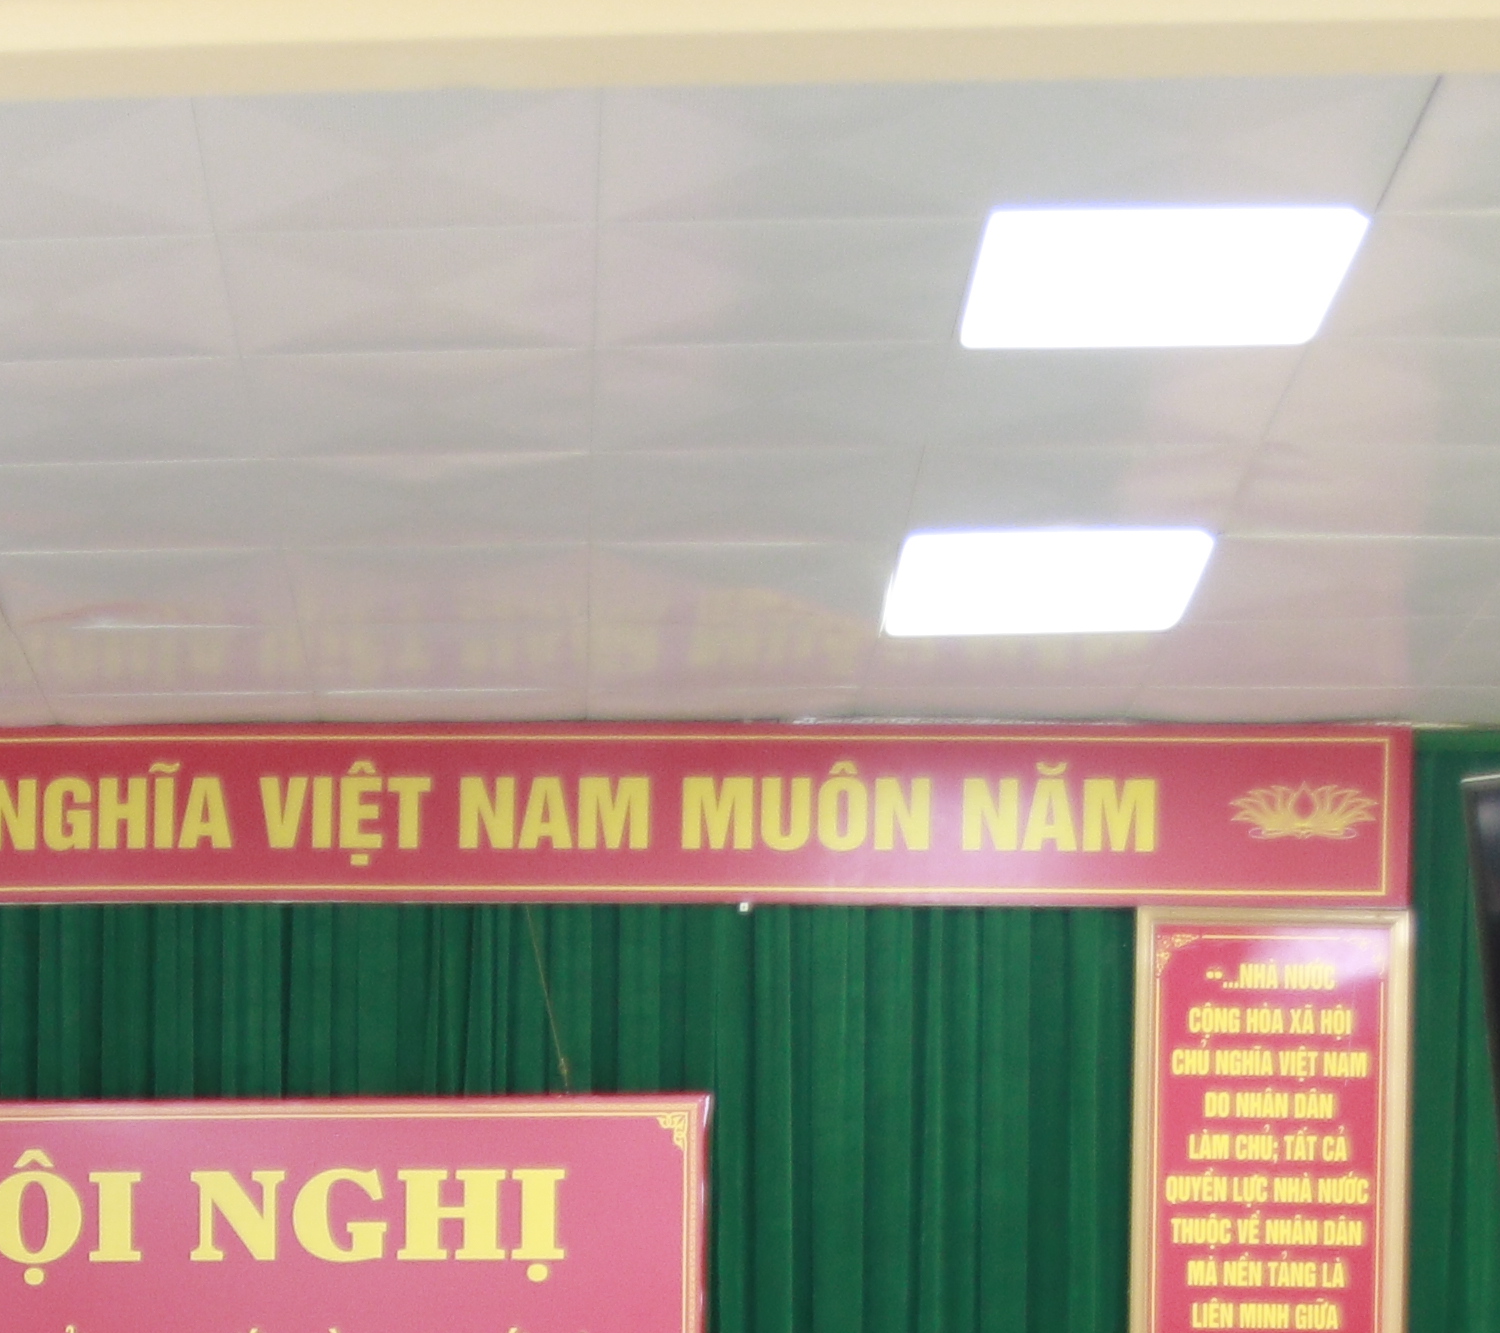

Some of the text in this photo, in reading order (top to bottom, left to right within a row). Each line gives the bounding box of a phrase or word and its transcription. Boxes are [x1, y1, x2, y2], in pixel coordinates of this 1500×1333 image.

[259, 760, 432, 867] VIỆT
[459, 776, 651, 850] NAM
[681, 761, 937, 857] MUÔN
[957, 762, 1158, 858] NĂM
[1189, 1002, 1353, 1040] CỘNG HÒA XÃ HỘI
[1172, 1039, 1367, 1081] CHỦ NGHĨA VIỆT NAM
[1205, 1088, 1334, 1118] DO NHÂN DÂN
[1189, 1129, 1230, 1159] LÀM
[1284, 1127, 1317, 1160] TẤT
[1322, 1126, 1348, 1161] CẢ
[1232, 1175, 1268, 1207] LỰC
[1274, 1173, 1312, 1202] NHÀ
[1318, 1172, 1369, 1204] NƯỚC
[190, 1167, 566, 1283] NGHỊ
[1171, 1213, 1232, 1249] THUỘC
[1266, 1215, 1315, 1245] NHÂN
[1324, 1216, 1363, 1245] DÂN
[1188, 1256, 1218, 1285] MÀ
[1267, 1251, 1317, 1287] TẢNG
[1322, 1258, 1344, 1287] LÀ
[1193, 1298, 1339, 1329] LIÊN MINH GIỮA
